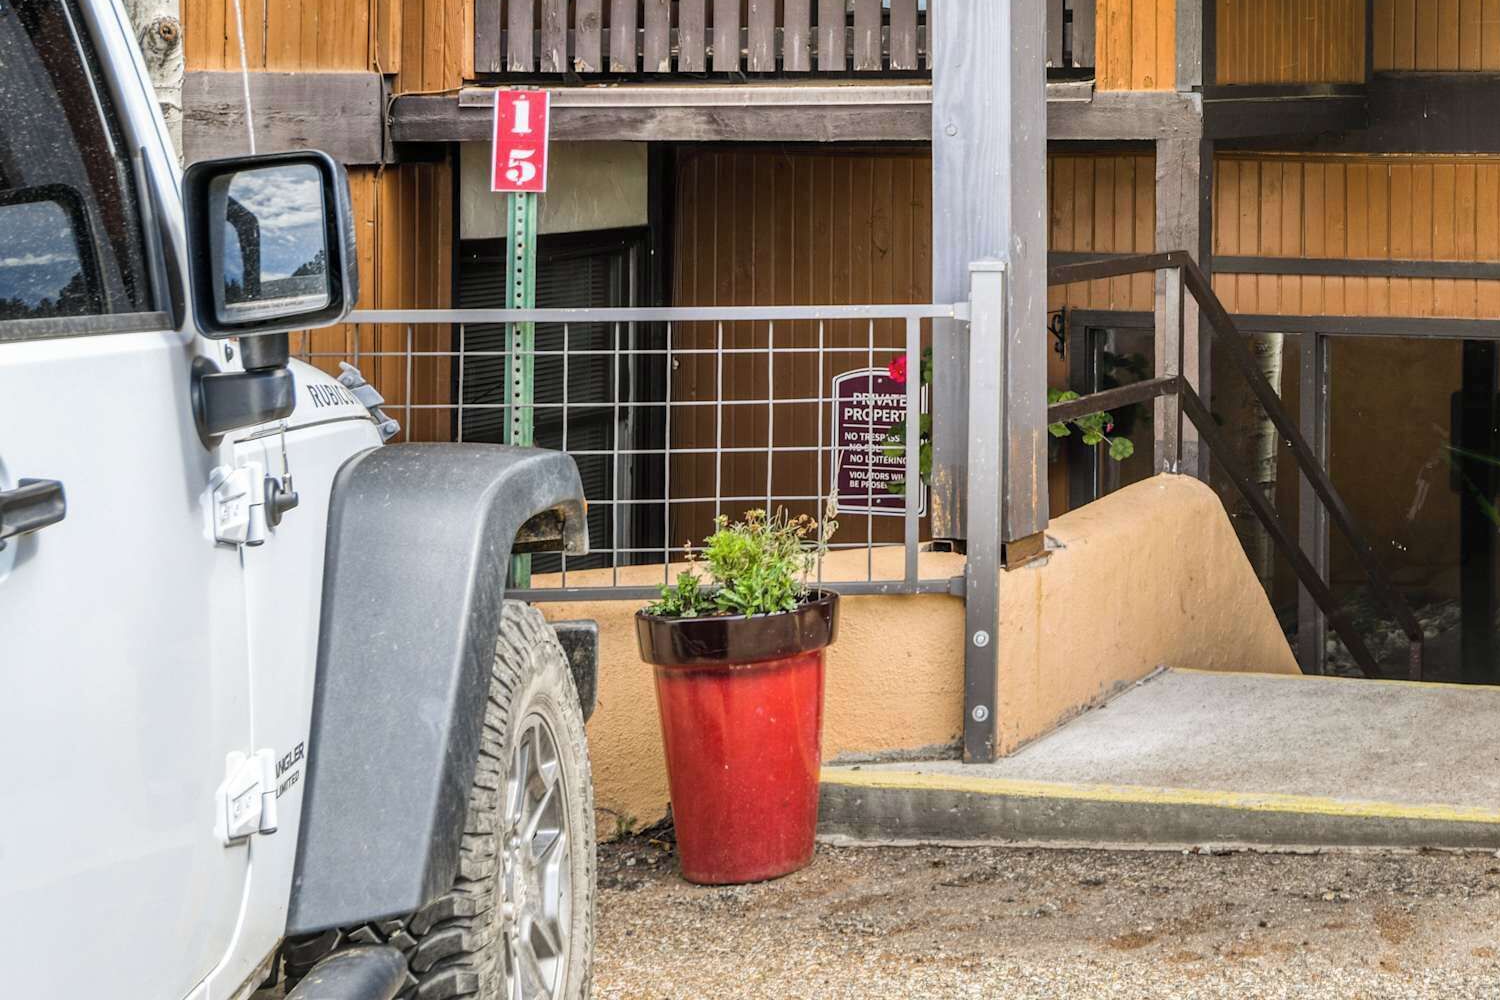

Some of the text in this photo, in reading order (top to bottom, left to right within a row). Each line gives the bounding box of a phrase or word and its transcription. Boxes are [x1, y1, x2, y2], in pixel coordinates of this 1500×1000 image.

[844, 407, 907, 422] PROPERT
[844, 431, 858, 441] NO
[849, 454, 864, 463] NO
[849, 480, 860, 488] BE
